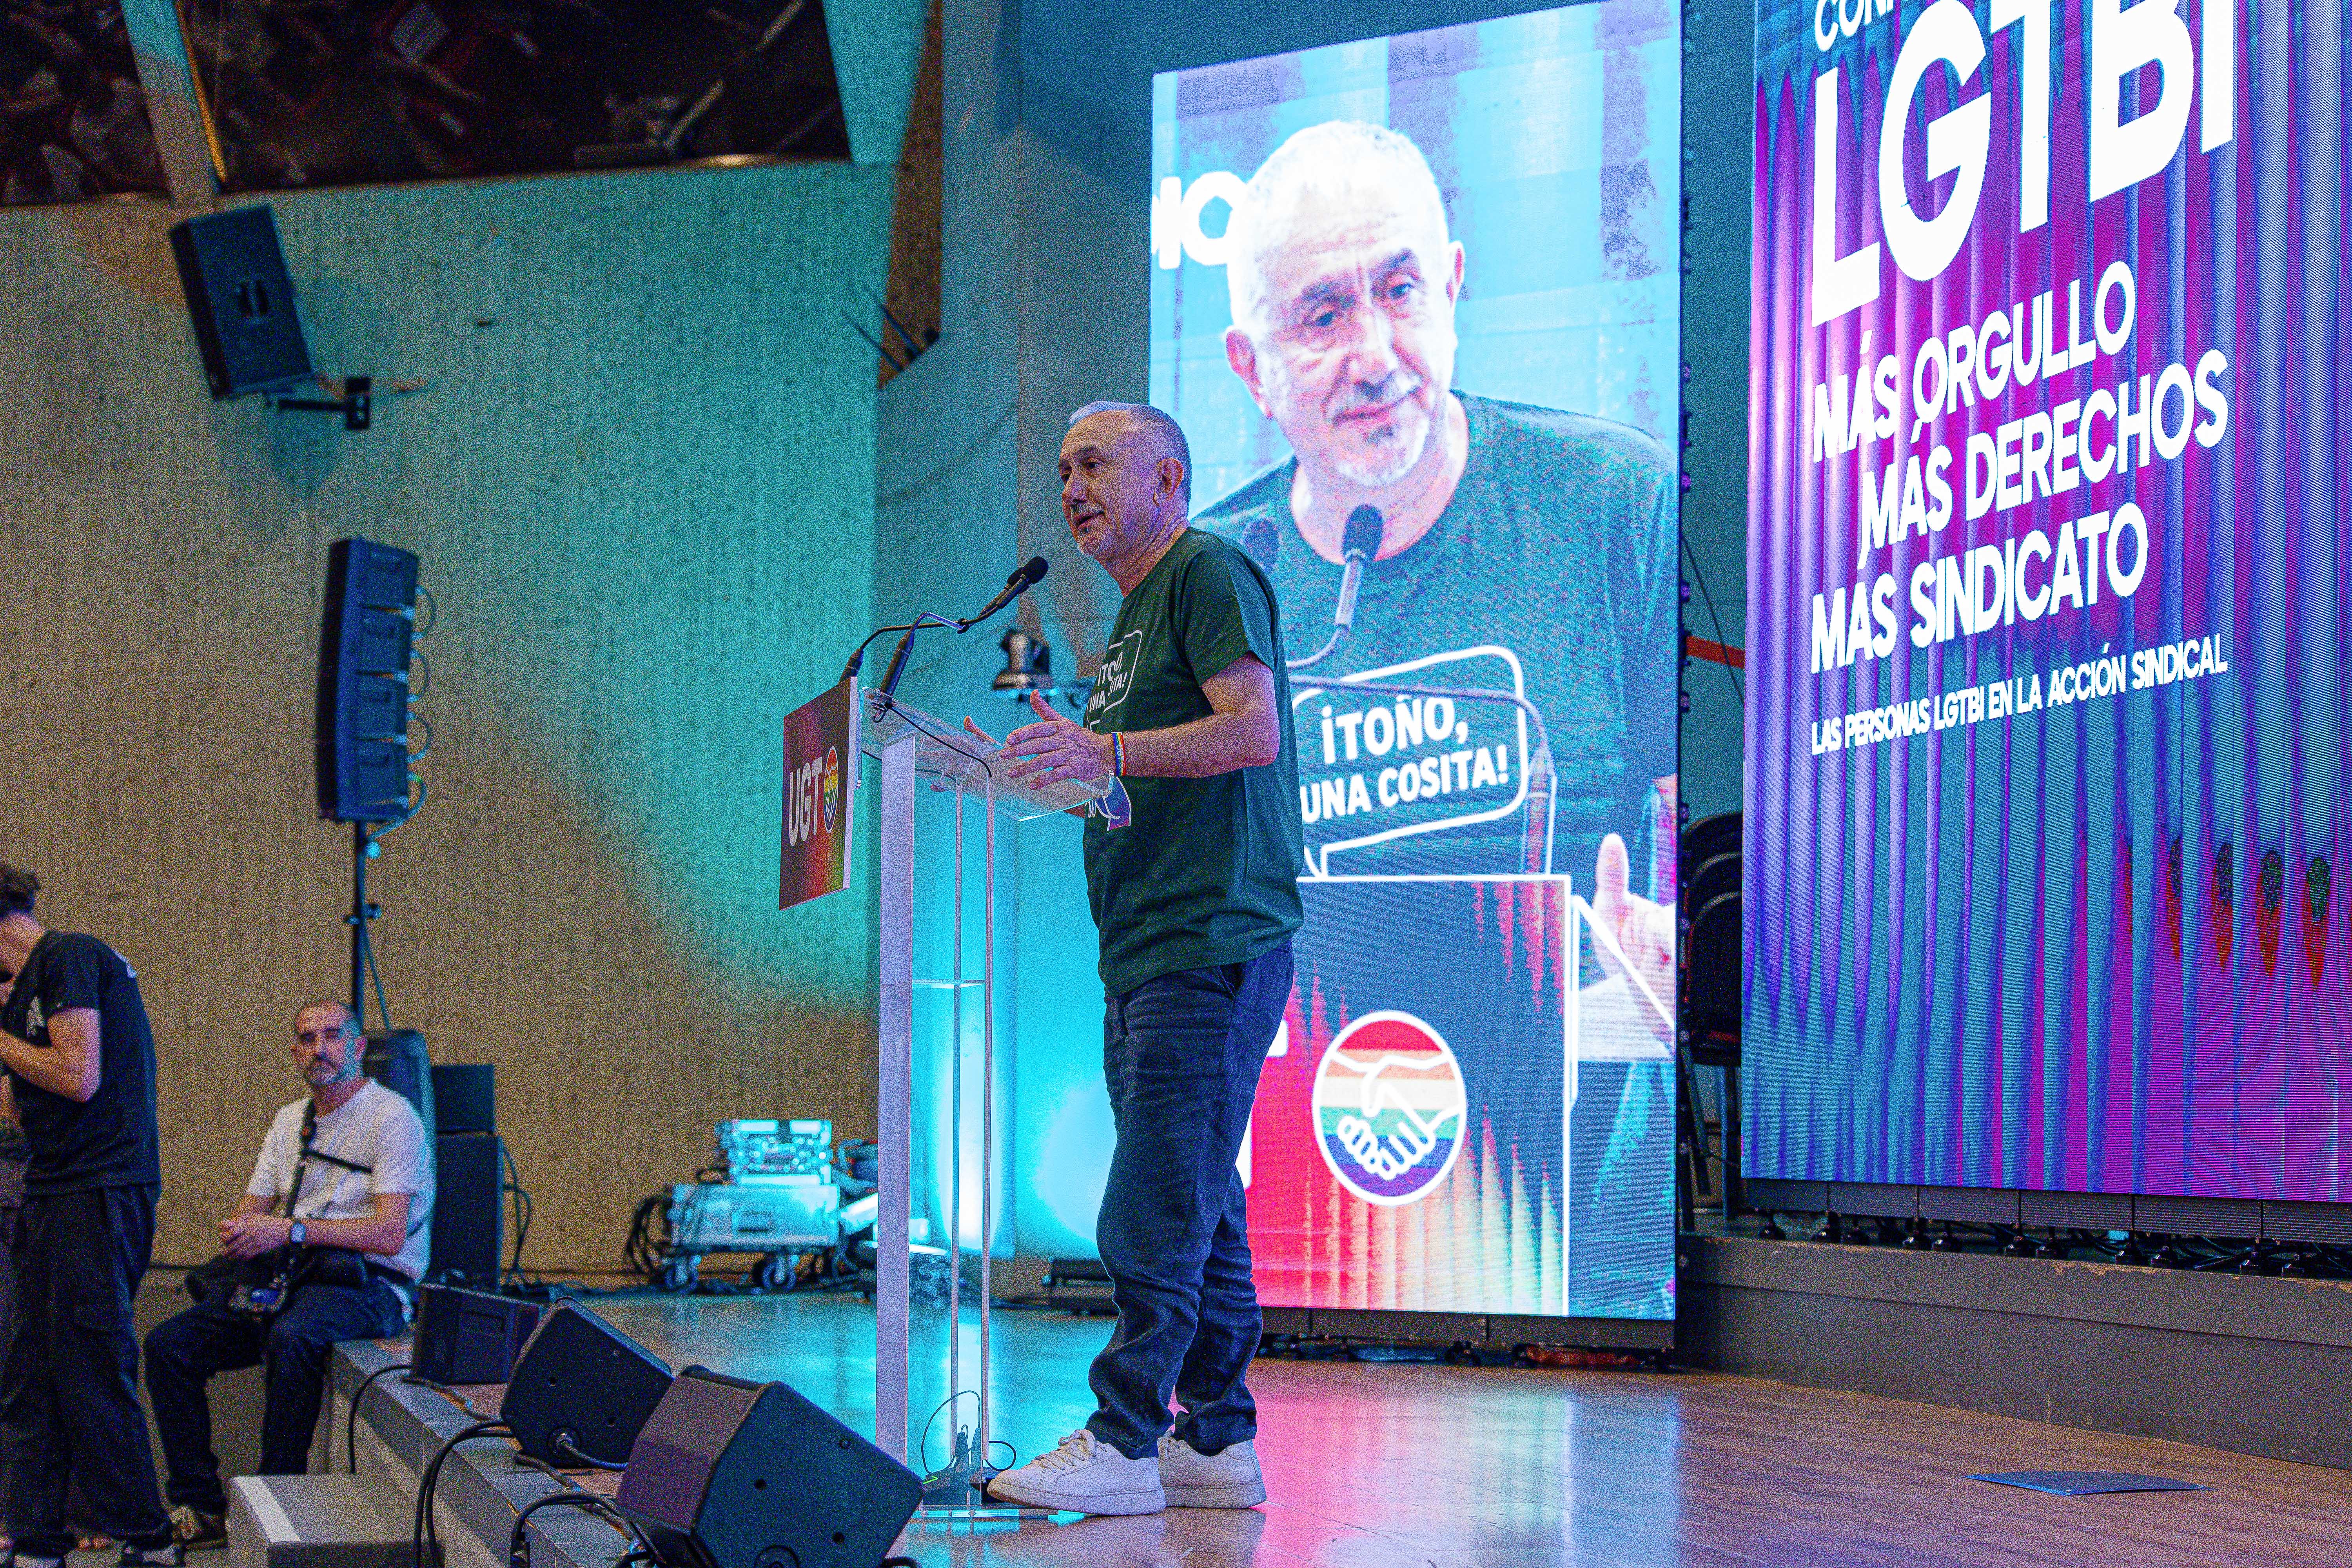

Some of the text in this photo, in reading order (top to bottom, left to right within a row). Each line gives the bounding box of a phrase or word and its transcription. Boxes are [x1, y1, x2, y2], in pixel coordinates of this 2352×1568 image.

[1811, 0, 2234, 327] LGTBI
[1813, 260, 2136, 463] MÁS ORGULLO
[1863, 349, 2229, 549] MÁS DERECHOS
[1811, 502, 2148, 673] MÁS SINDICATO
[1116, 744, 1125, 761] UGT
[1321, 695, 1468, 764] ¡TOÑO,
[1811, 633, 2228, 755] LAS PERSONAS LGTBI EN LA ACCIÓN SINDICAL
[789, 757, 822, 846] UGT
[1300, 745, 1509, 823] UNA COSITA!
